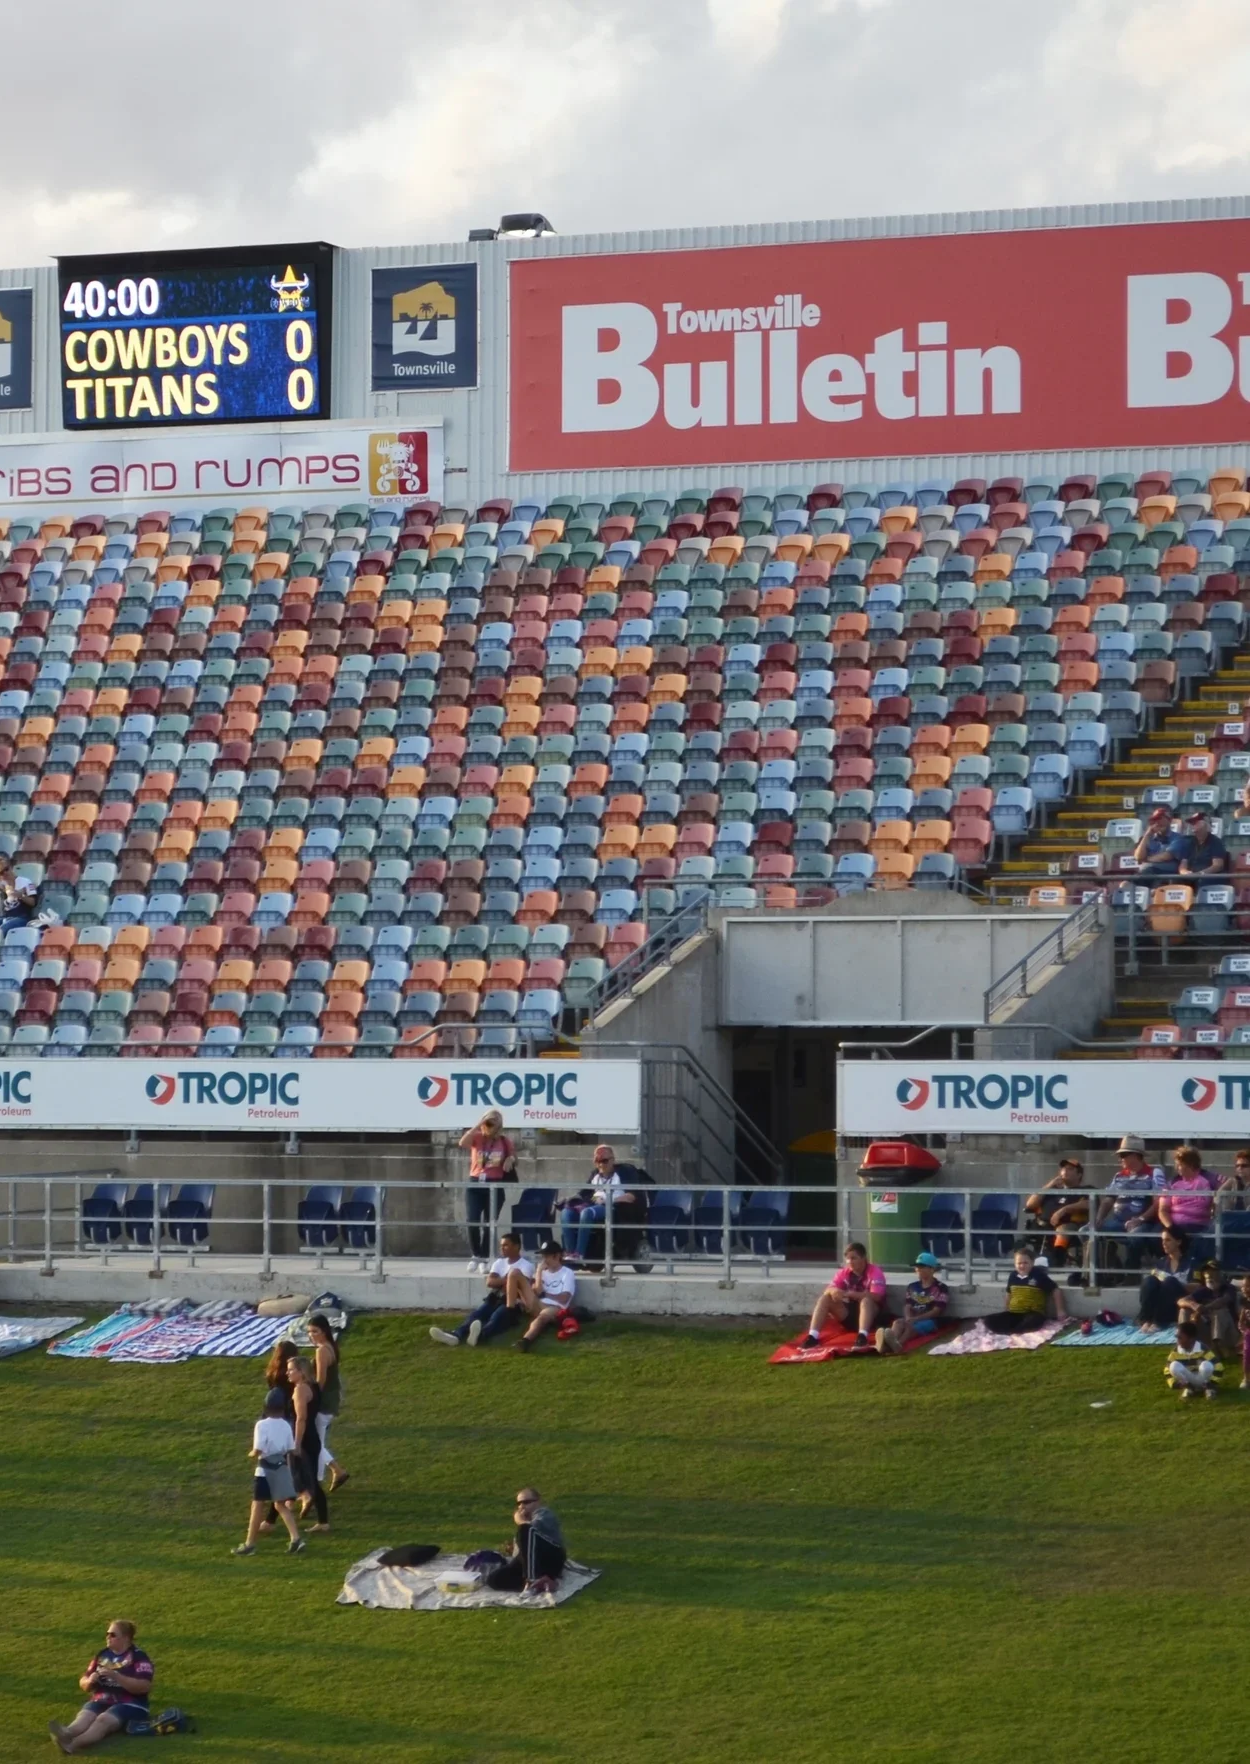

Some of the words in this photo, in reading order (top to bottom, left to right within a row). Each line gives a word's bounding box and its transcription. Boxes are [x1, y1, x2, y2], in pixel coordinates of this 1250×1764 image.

[64, 277, 159, 318] 40:00
[663, 294, 821, 334] Townsville
[65, 323, 248, 372] COWBOYS
[286, 320, 312, 361] 0
[393, 360, 456, 376] Townsville
[562, 302, 1021, 433] Bulletin
[67, 372, 219, 419] TITANS
[288, 369, 314, 410] 0
[1196, 735, 1204, 743] N
[1161, 767, 1169, 775] M
[1051, 865, 1057, 873] J
[178, 1072, 299, 1105] TROPIC
[451, 1073, 577, 1106] TROPIC
[932, 1074, 1067, 1109] TROPIC
[247, 1108, 300, 1119] Petroleum
[523, 1109, 577, 1120] Petroleum
[1010, 1111, 1069, 1124] Petroleum
